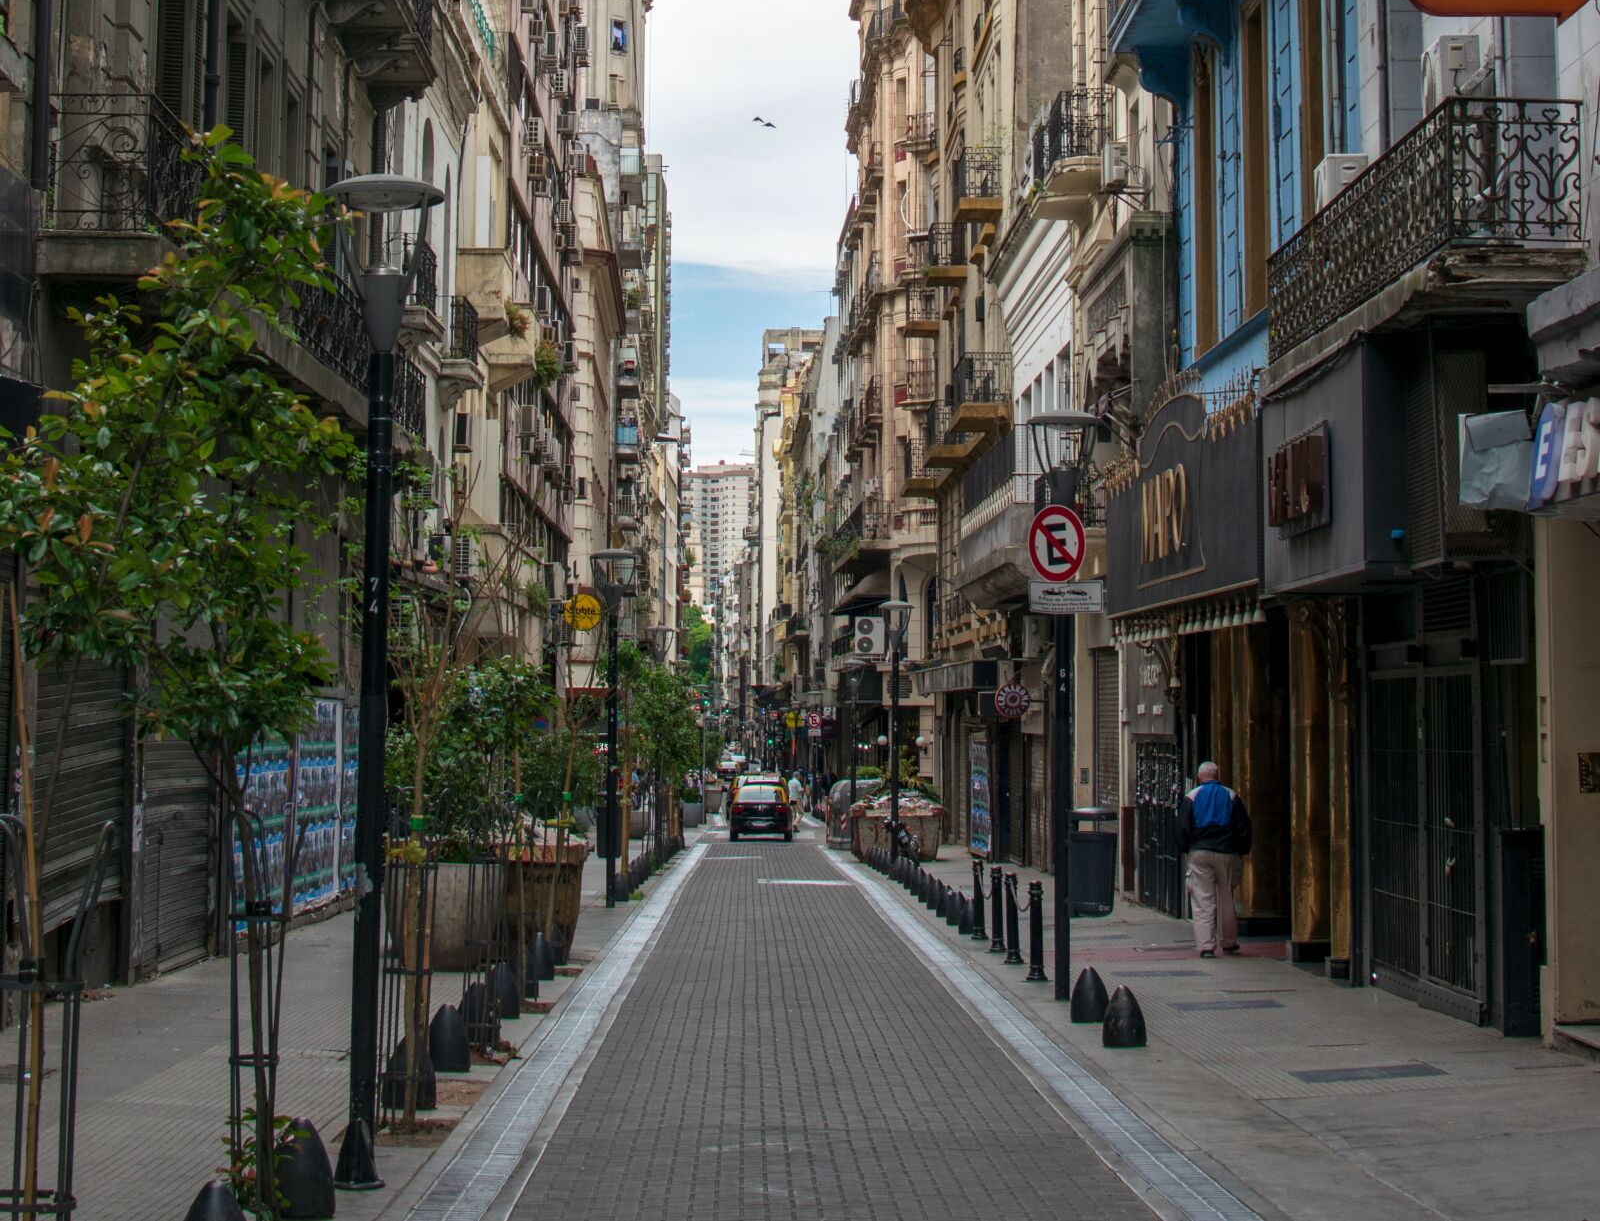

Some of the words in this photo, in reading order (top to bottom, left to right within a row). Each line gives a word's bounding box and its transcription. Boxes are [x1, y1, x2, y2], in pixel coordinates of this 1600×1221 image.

[1534, 420, 1554, 480] E
[1557, 396, 1600, 482] ES
[1044, 522, 1070, 566] E
[569, 605, 596, 616] Subte
